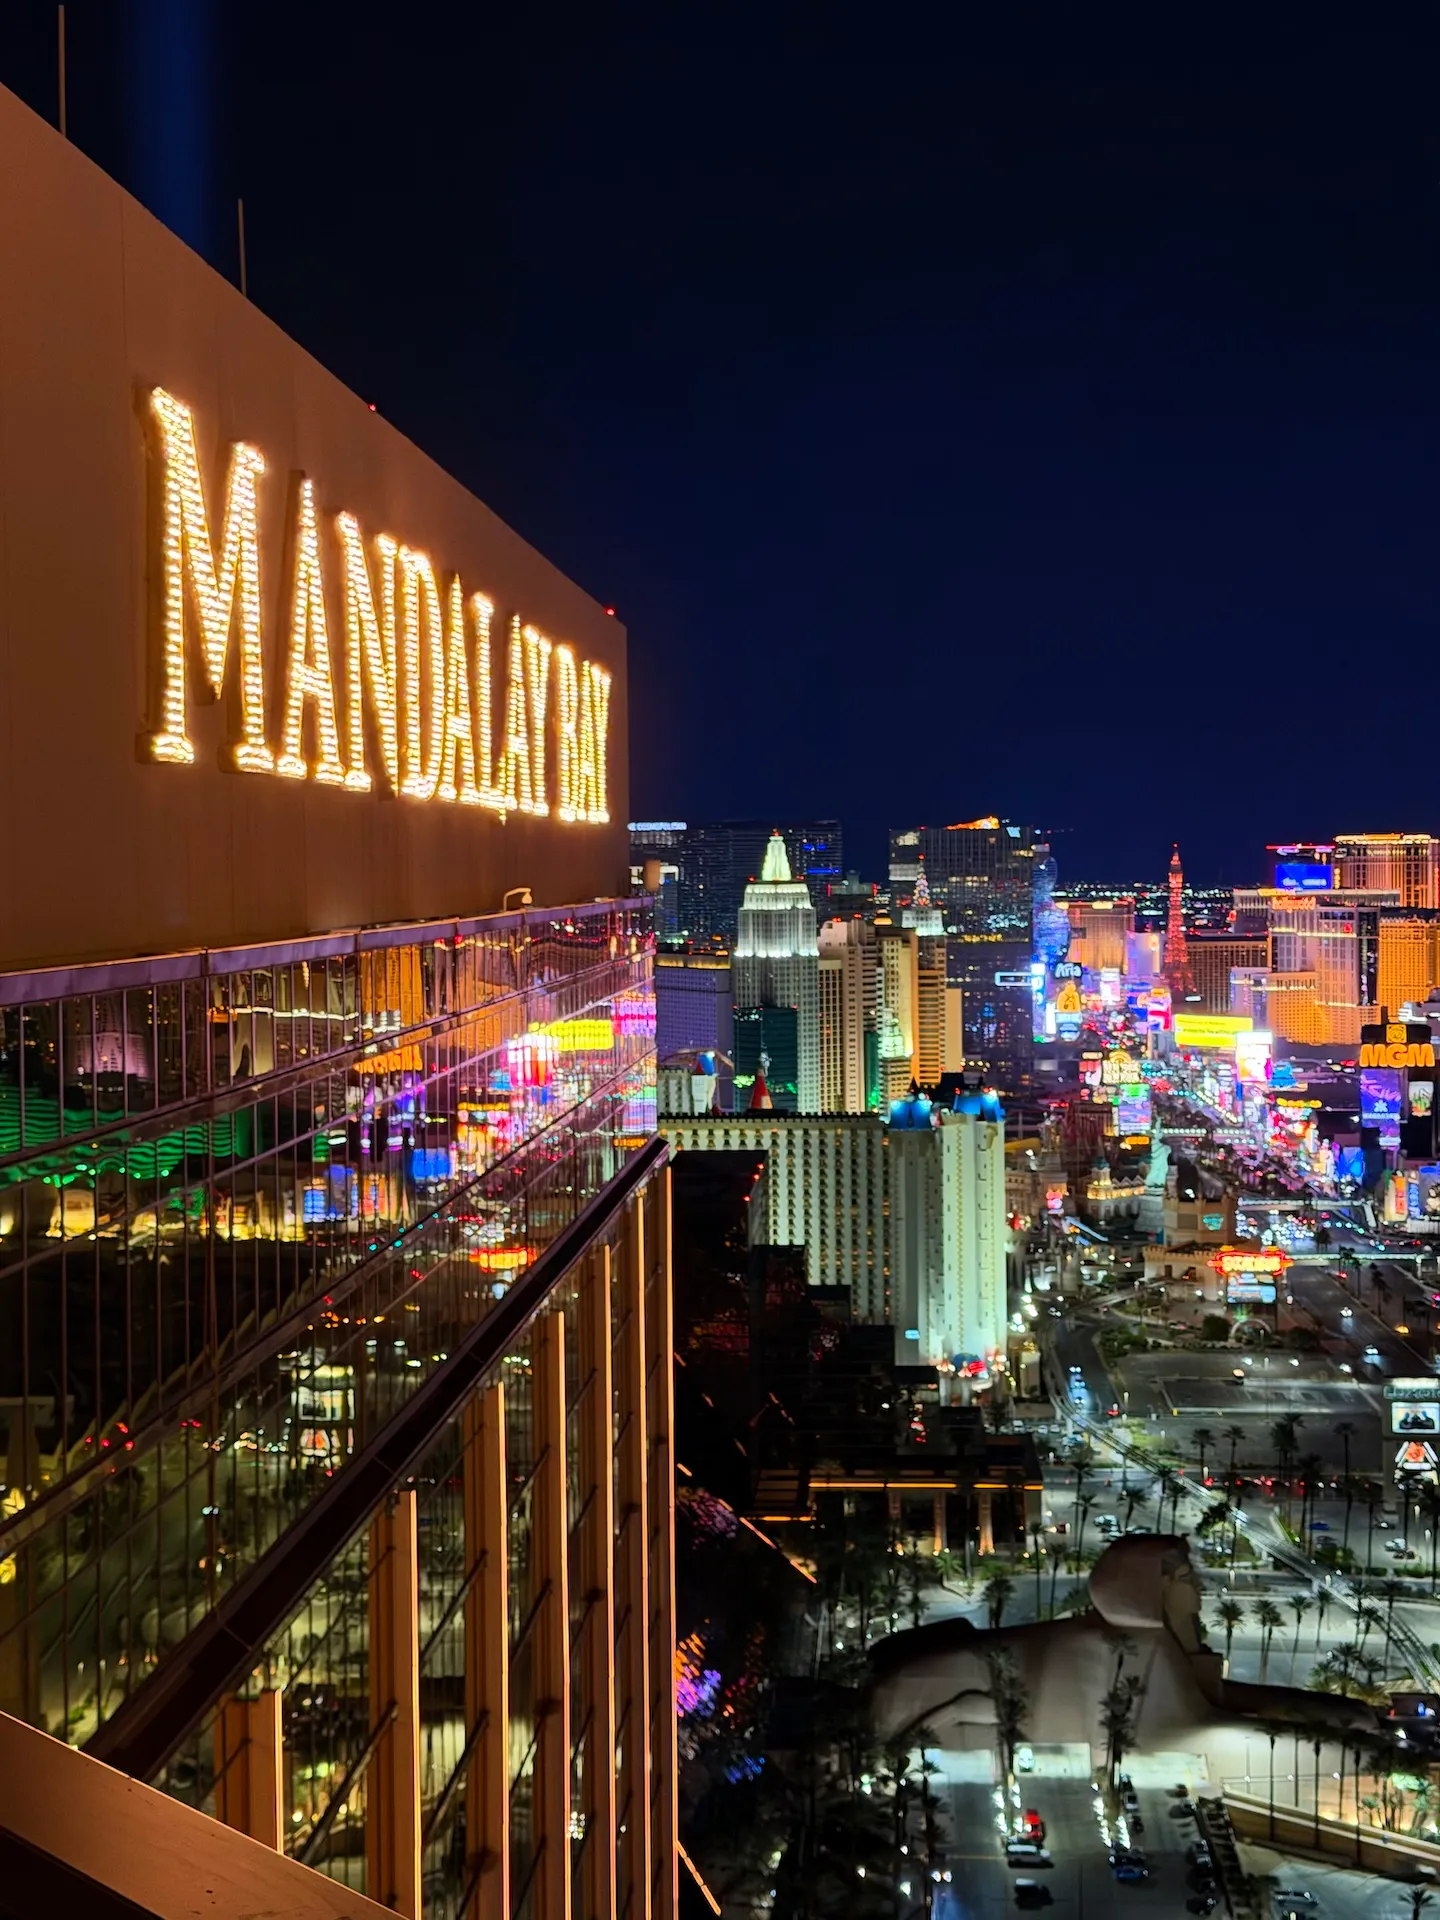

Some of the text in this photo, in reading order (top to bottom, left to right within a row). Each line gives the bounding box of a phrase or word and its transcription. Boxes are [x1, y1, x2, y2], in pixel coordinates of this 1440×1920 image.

[152, 386, 612, 825] MANDALAY BAY
[1055, 962, 1082, 978] Aria
[1359, 1043, 1436, 1069] MGM
